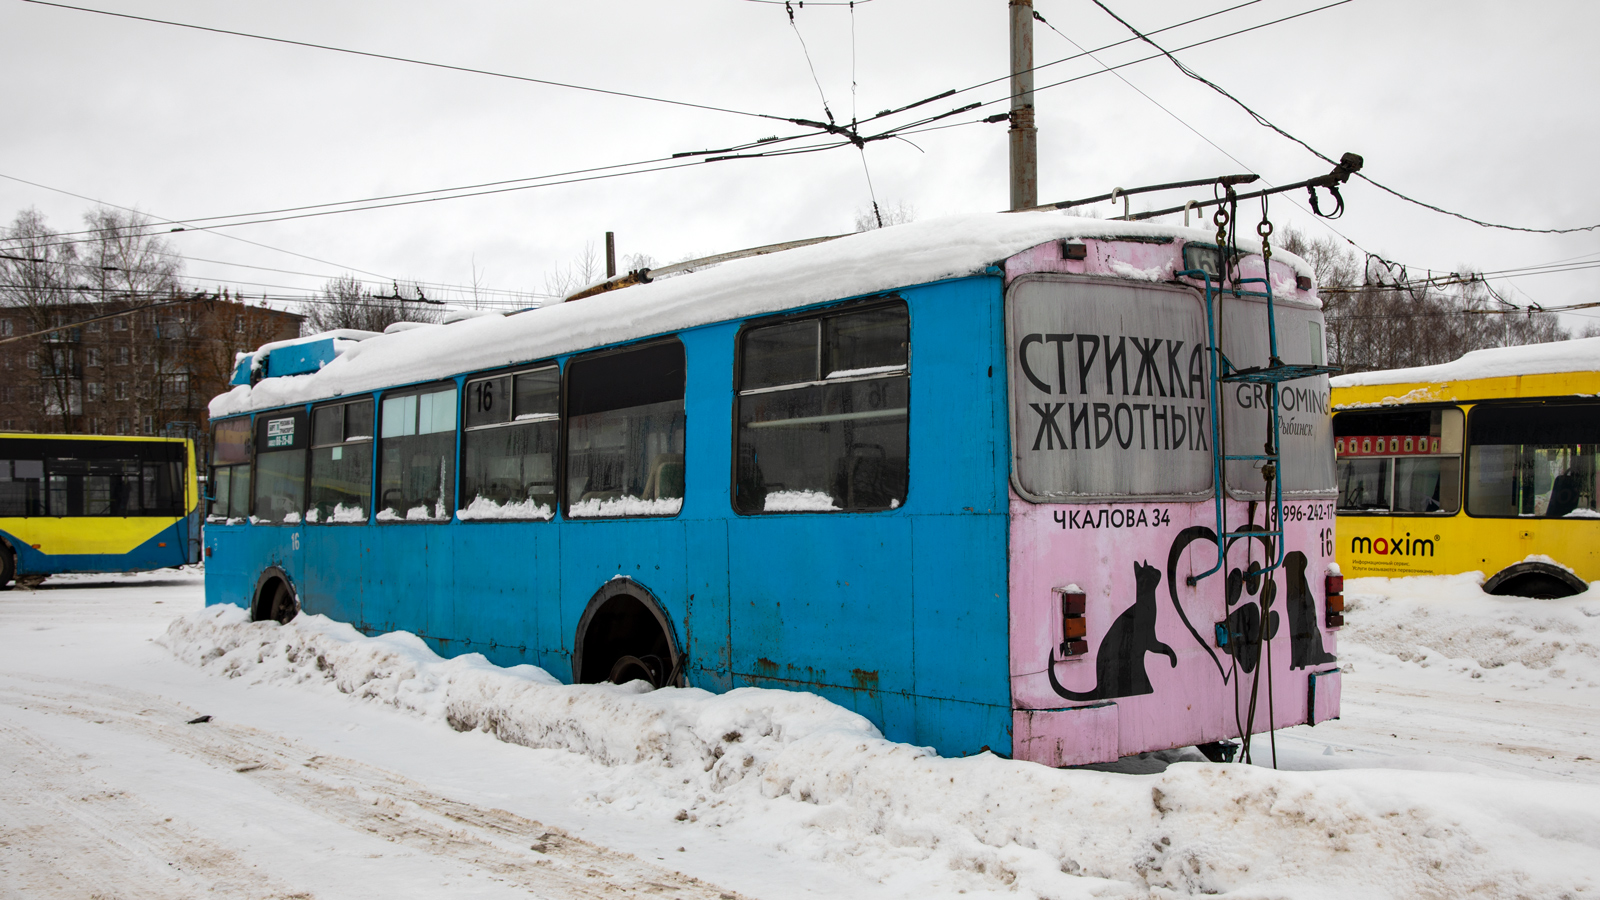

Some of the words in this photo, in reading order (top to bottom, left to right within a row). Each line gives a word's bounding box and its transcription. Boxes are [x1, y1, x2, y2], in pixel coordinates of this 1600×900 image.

[1019, 333, 1206, 400] СТРИЖКА
[475, 381, 493, 412] 16
[1029, 402, 1208, 451] ЖИВОТНЫХ
[1053, 509, 1148, 529] ЧКАЛОВА
[1151, 508, 1170, 527] 34
[291, 532, 300, 551] 16
[1320, 527, 1333, 558] 16
[1351, 532, 1434, 557] maxim
